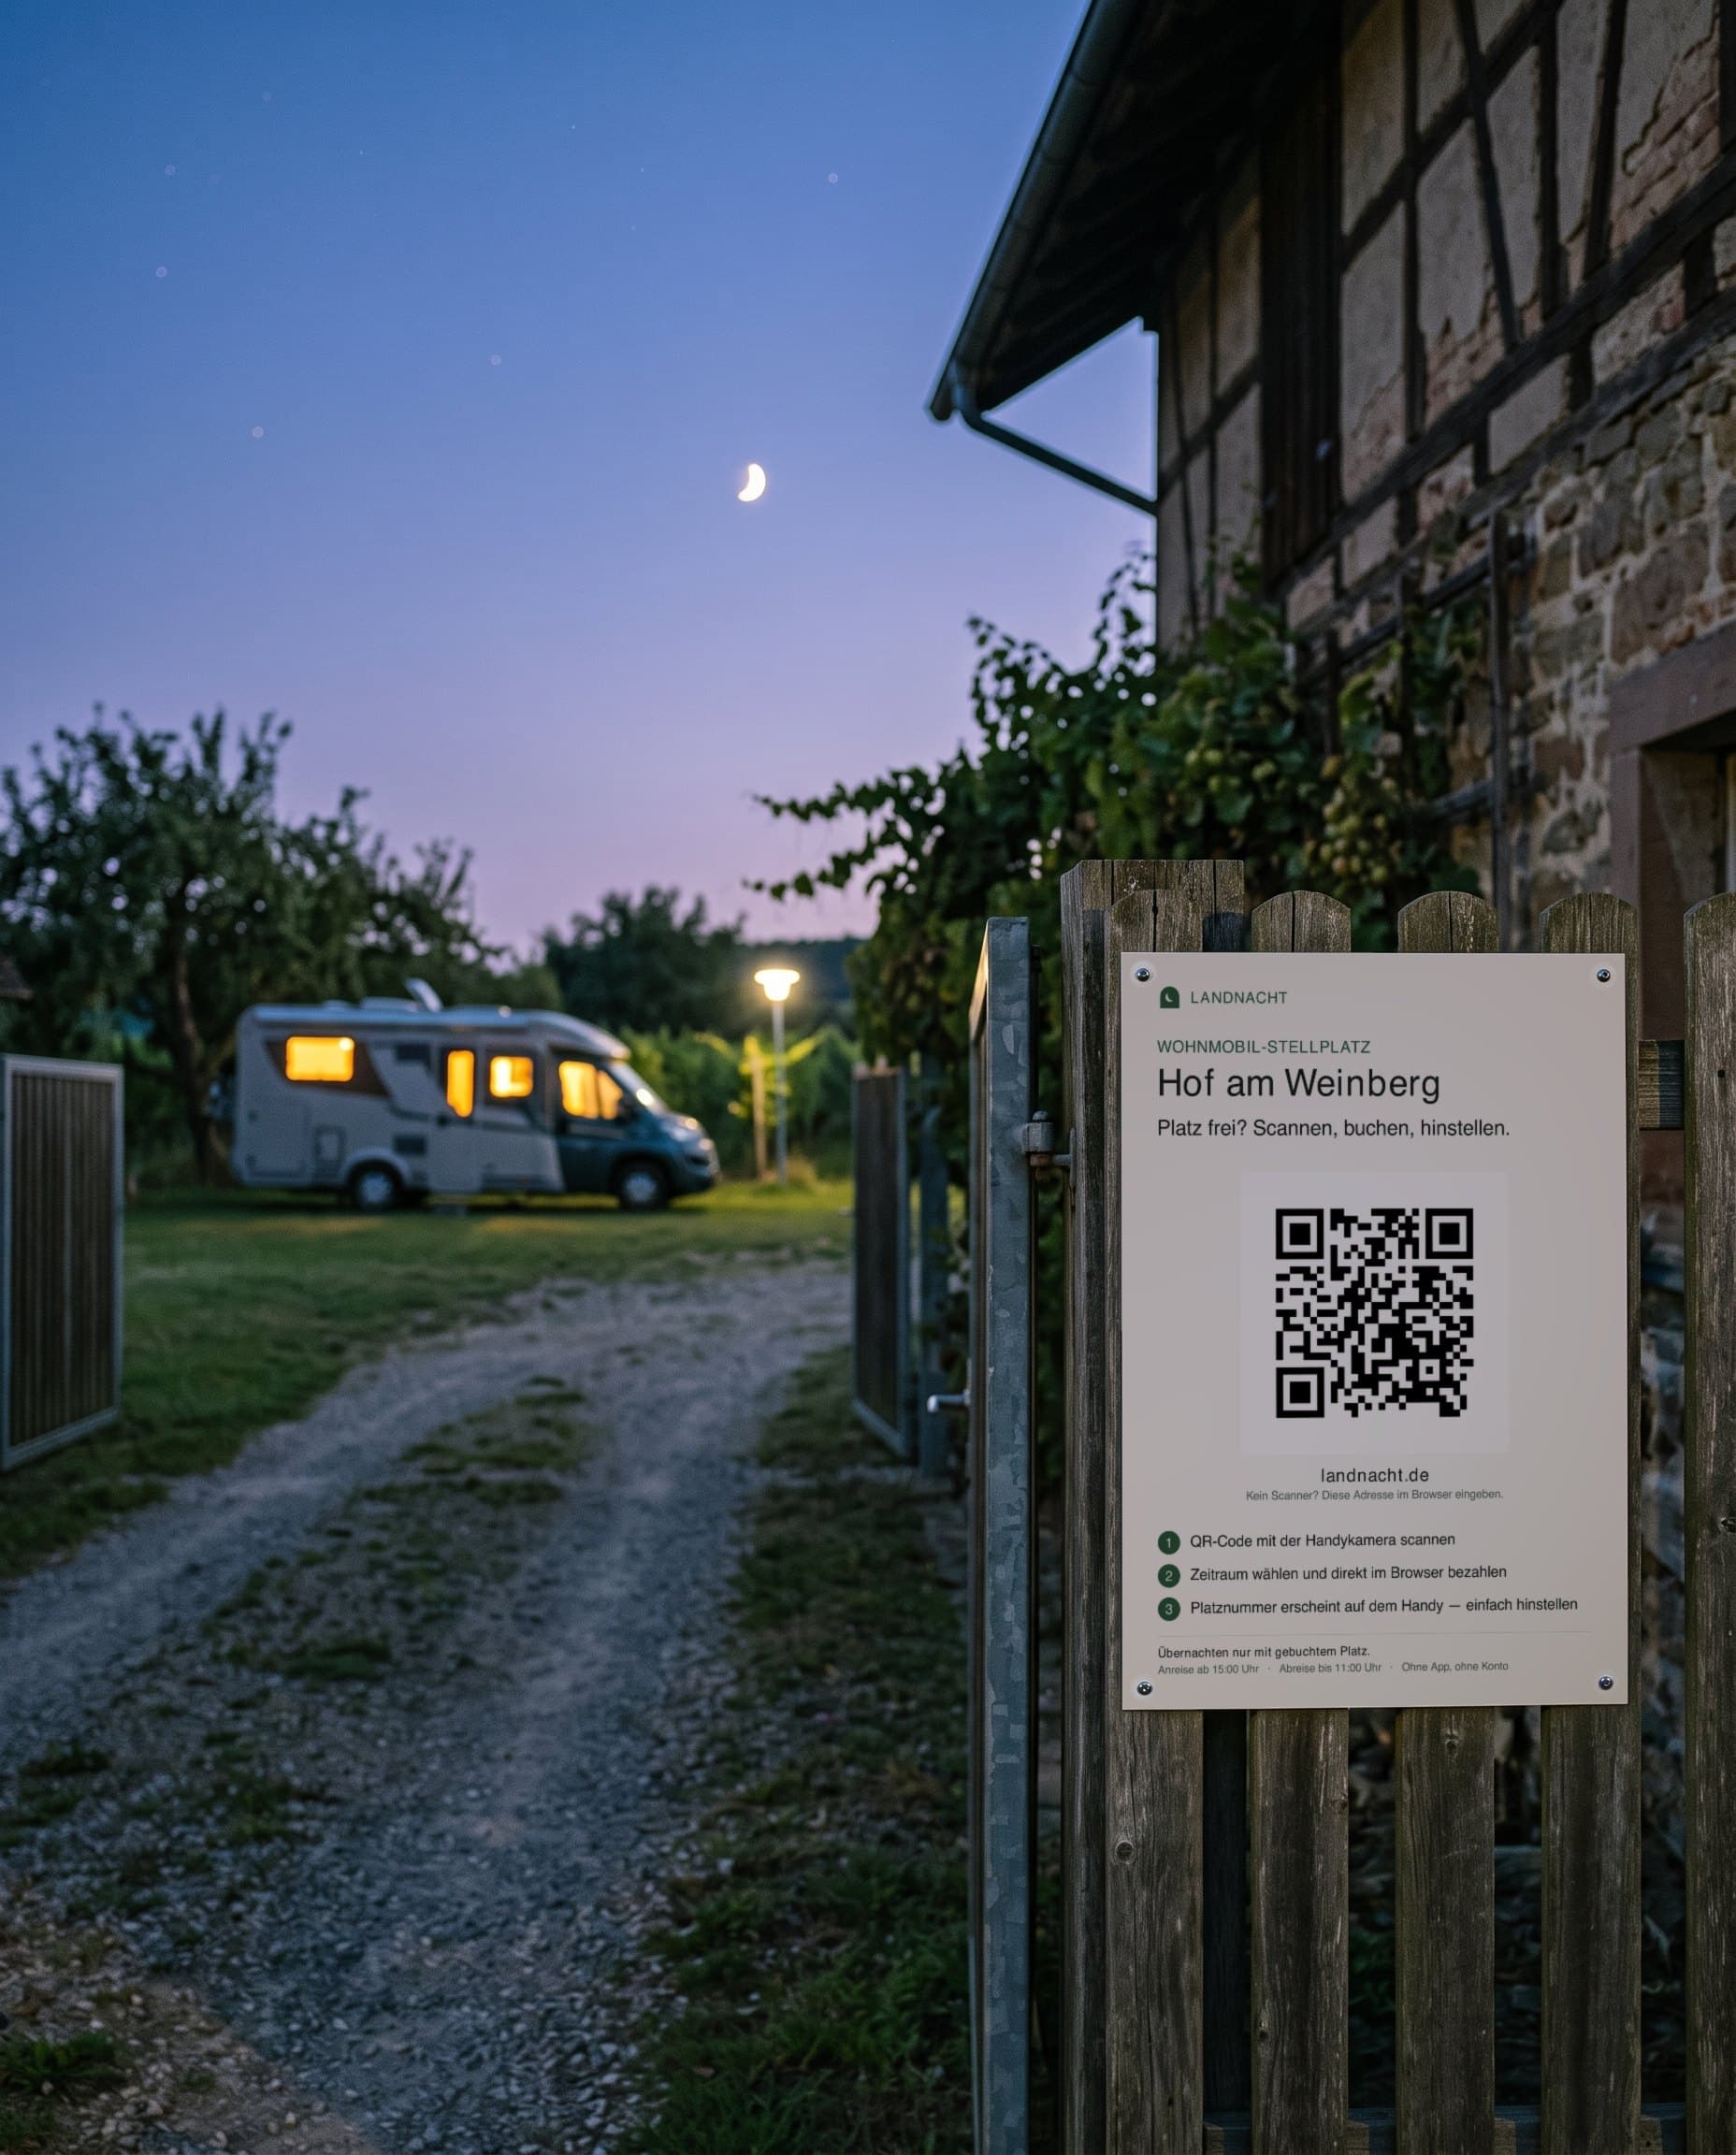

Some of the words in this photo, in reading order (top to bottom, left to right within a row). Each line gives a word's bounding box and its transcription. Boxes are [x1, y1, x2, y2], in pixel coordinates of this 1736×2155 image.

[1191, 991, 1288, 1005] LANDNACHT
[1156, 1039, 1371, 1054] WOHNMOBIL-STELLPLATZ
[1159, 1067, 1215, 1097] Hof
[1226, 1075, 1274, 1097] am
[1284, 1067, 1439, 1105] Weinberg
[1158, 1119, 1203, 1136] Platz
[1208, 1119, 1248, 1136] frei?
[1252, 1119, 1338, 1139] Scannen,
[1343, 1118, 1414, 1139] buchen,
[1421, 1119, 1510, 1136] hinstellen.
[1321, 1467, 1430, 1483] landnacht.de
[1246, 1491, 1268, 1500] Kein
[1271, 1490, 1320, 1500] Scanner?
[1321, 1490, 1352, 1500] Diese
[1353, 1490, 1395, 1500] Adresse
[1396, 1490, 1410, 1499] im
[1410, 1489, 1453, 1499] Browser
[1165, 1537, 1172, 1549] 1
[1190, 1534, 1253, 1549] QR-Code
[1256, 1534, 1277, 1548] mit
[1280, 1534, 1302, 1548] der
[1306, 1533, 1396, 1550] Handykamera
[1399, 1535, 1455, 1547] scannen
[1165, 1569, 1174, 1583] 2
[1189, 1568, 1249, 1582] Zeitraum
[1251, 1567, 1299, 1581] wählen
[1302, 1567, 1327, 1580] und
[1330, 1566, 1368, 1580] direkt
[1370, 1566, 1387, 1580] im
[1391, 1566, 1445, 1580] Browser
[1448, 1565, 1508, 1579] bezahlen
[1165, 1602, 1174, 1616] 3
[1191, 1600, 1278, 1615] Platznummer
[1280, 1599, 1341, 1613] erscheint
[1343, 1598, 1366, 1613] auf
[1368, 1598, 1398, 1613] dem
[1401, 1598, 1444, 1615] Handy
[1466, 1598, 1512, 1613] einfach
[1516, 1597, 1578, 1612] hinstellen
[1157, 1646, 1229, 1659] Übernachten
[1232, 1650, 1251, 1658] nur
[1253, 1646, 1272, 1658] mit
[1274, 1647, 1337, 1660] gebuchtem
[1339, 1646, 1370, 1656] Platz.
[1157, 1665, 1195, 1674] Anreise
[1196, 1665, 1209, 1674] ab
[1212, 1664, 1239, 1674] 15:00
[1241, 1664, 1260, 1673] Uhr
[1279, 1664, 1316, 1673] Abreise
[1317, 1663, 1333, 1672] bis
[1335, 1663, 1363, 1672] 11:00
[1364, 1662, 1382, 1672] Uhr
[1401, 1662, 1429, 1671] Ohne
[1454, 1662, 1480, 1671] ohne
[1481, 1661, 1509, 1670] Konto
